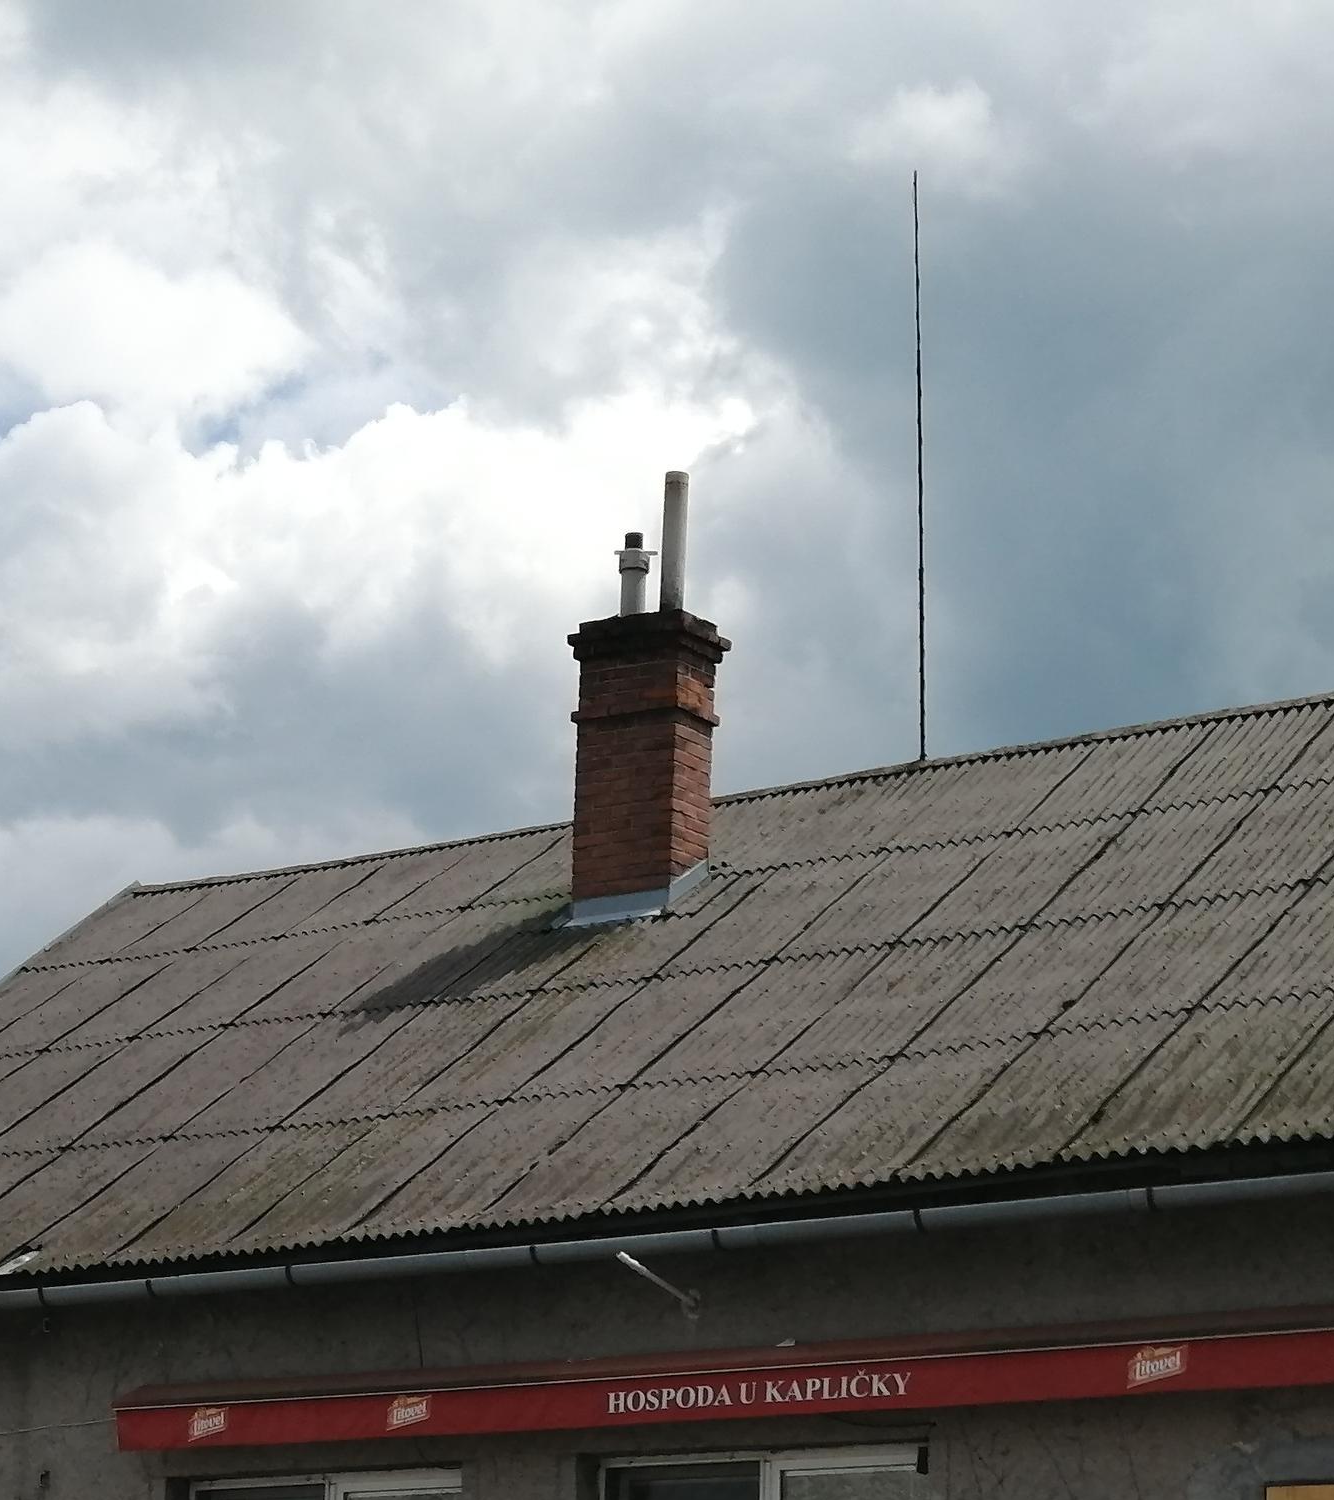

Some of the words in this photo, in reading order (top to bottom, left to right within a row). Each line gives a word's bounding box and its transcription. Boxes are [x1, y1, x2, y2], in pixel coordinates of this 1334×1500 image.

[1136, 1351, 1180, 1379] Litovel
[607, 1387, 732, 1414] HOSPODA
[739, 1382, 757, 1405] U
[765, 1369, 912, 1403] KAPLIČKY
[194, 1412, 224, 1436] Litovel
[394, 1400, 428, 1424] Litovel
